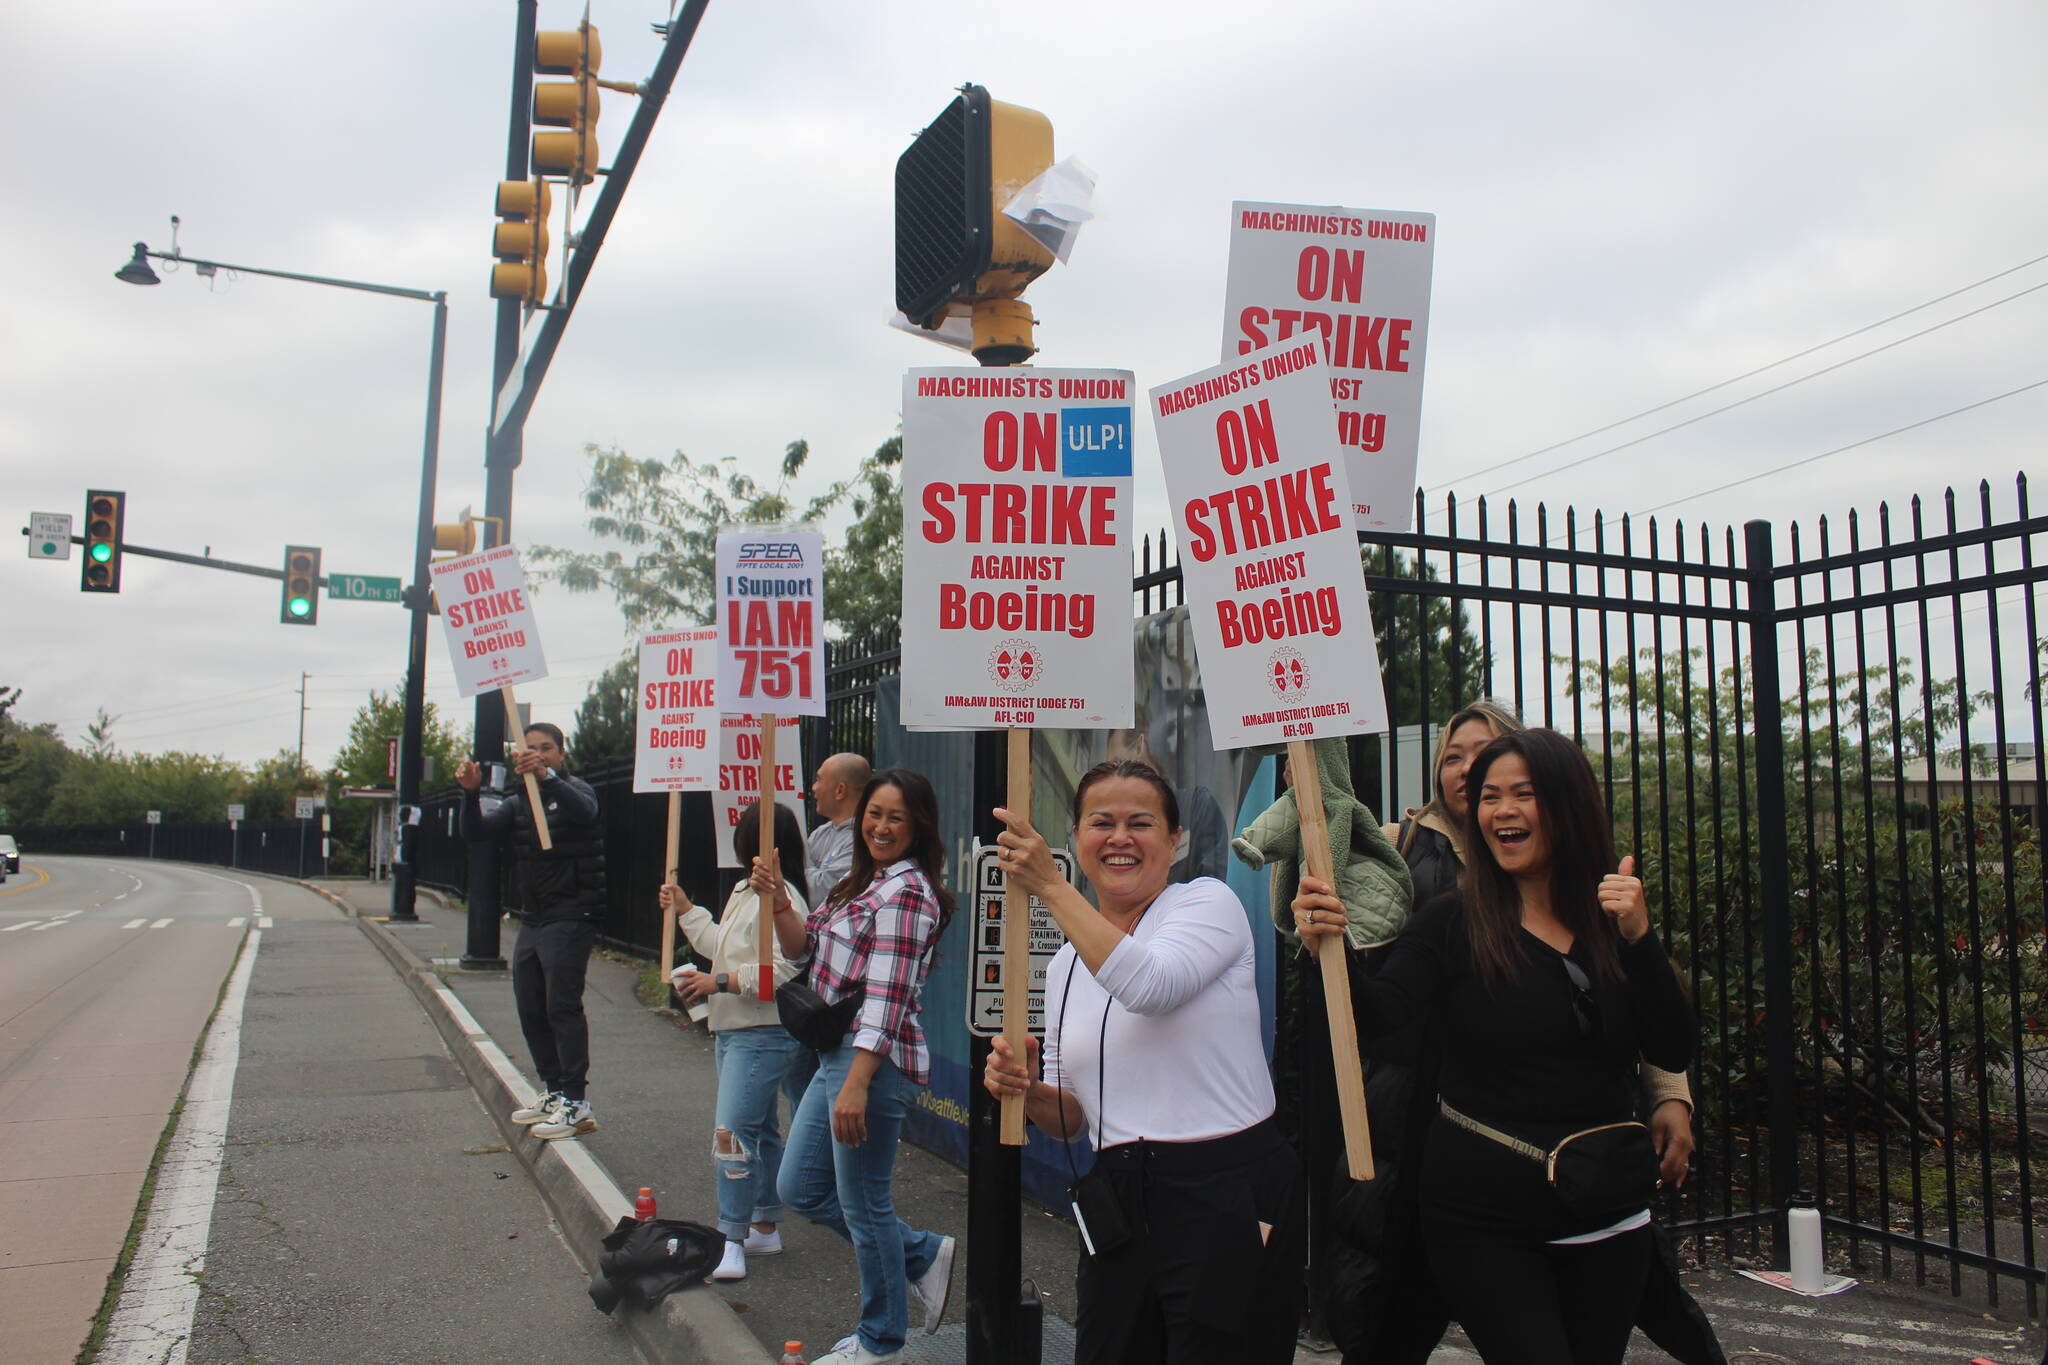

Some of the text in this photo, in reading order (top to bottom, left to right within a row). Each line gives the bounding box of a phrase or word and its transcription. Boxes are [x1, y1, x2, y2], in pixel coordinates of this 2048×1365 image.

[1241, 211, 1427, 242] MACHINISTS UNION
[1297, 245, 1365, 304] ON
[1238, 306, 1412, 372] STRIKE
[918, 377, 1125, 399] MACHINISTS UNION
[1158, 342, 1317, 417] MACHINISTS UNION
[983, 410, 1057, 472] ON
[1069, 424, 1123, 451] ULP!
[1216, 398, 1279, 476] ON
[922, 482, 1116, 546] STRIKE
[1185, 462, 1341, 562] STRIKE
[1357, 504, 1371, 514] 751
[434, 549, 514, 575] MACHINISTS UNION
[739, 543, 803, 561] SPEEA
[464, 567, 495, 595] ON
[970, 555, 1065, 580] AGAINST
[1234, 551, 1306, 592] AGAINST
[331, 585, 339, 596] N
[385, 588, 398, 600] ST
[727, 576, 813, 597] I Support
[447, 588, 525, 628] STRIKE
[939, 584, 1095, 639] Boeing
[1216, 586, 1342, 649] Boeing
[473, 619, 509, 637] AGAINST
[728, 601, 813, 647] IAM
[464, 630, 526, 659] Boeing
[645, 632, 691, 645] MACHINISTS
[667, 648, 692, 676] ON
[735, 651, 812, 699] 751
[645, 680, 714, 710] STRIKE
[944, 696, 1085, 709] IAM&AW DISTRICT LODGE 751
[661, 713, 694, 725] AGAINST
[994, 711, 1035, 723] AFL-CIO
[1242, 702, 1351, 727] IAM&AW DISTRICT LODGE 751
[650, 727, 706, 749] Boeing
[1283, 722, 1314, 737] AFL-CIO
[1029, 930, 1061, 940] EMAINING
[1030, 919, 1047, 927] tarted
[993, 998, 1004, 1006] PU
